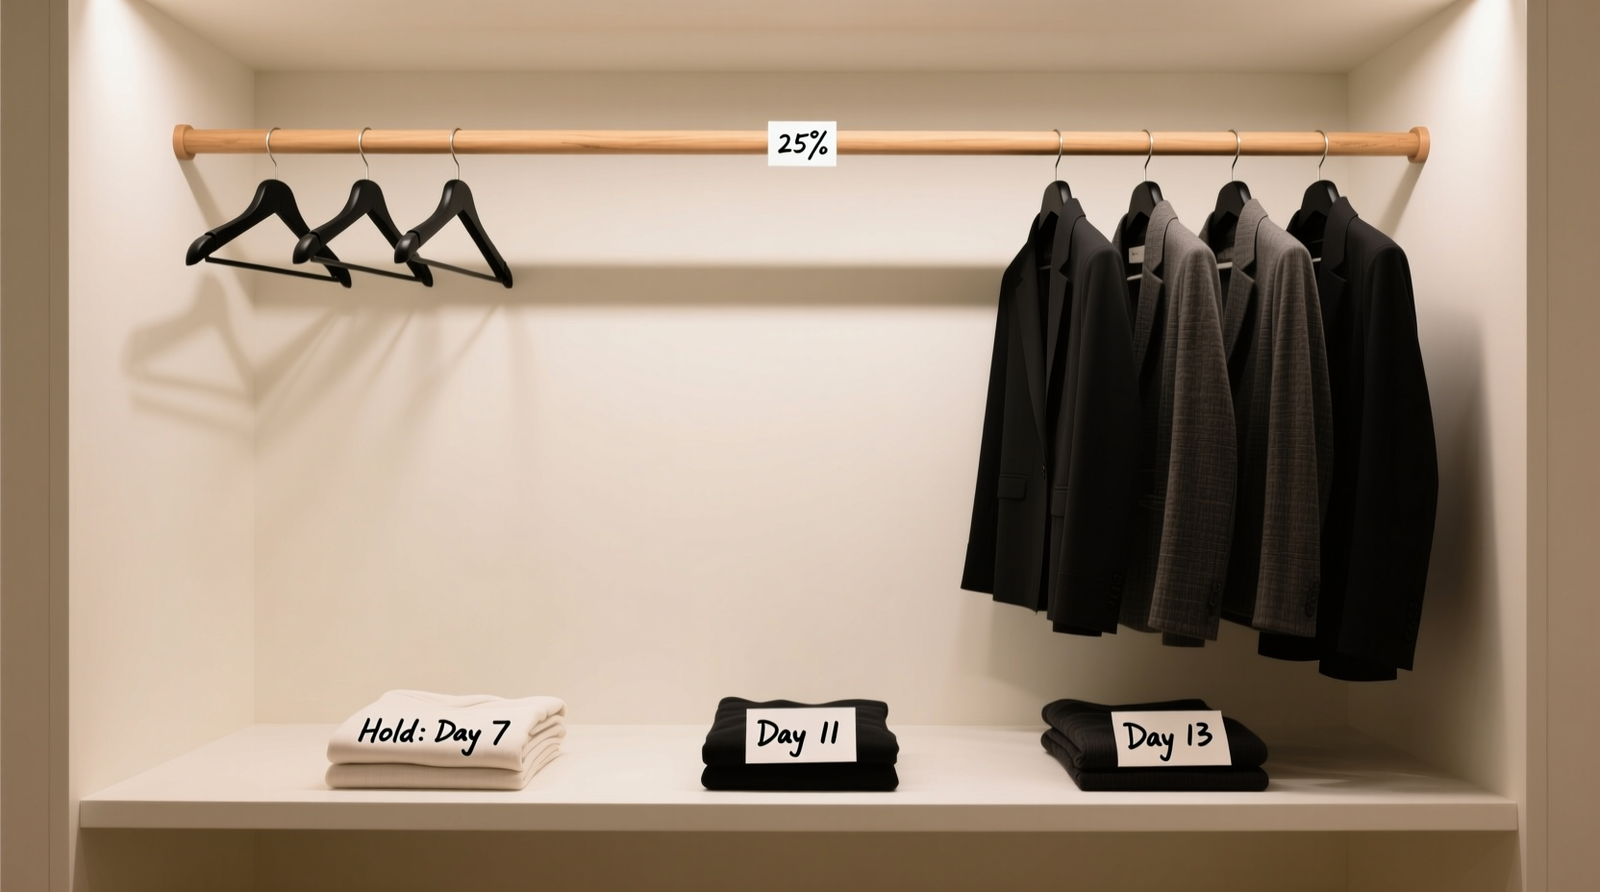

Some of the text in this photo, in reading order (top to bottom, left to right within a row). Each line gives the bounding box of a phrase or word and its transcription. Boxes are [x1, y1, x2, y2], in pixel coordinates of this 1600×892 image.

[777, 130, 828, 161] 25%
[357, 717, 511, 757] Hold: Day 7
[757, 719, 839, 758] Day 11
[1122, 721, 1213, 761] Day 13
